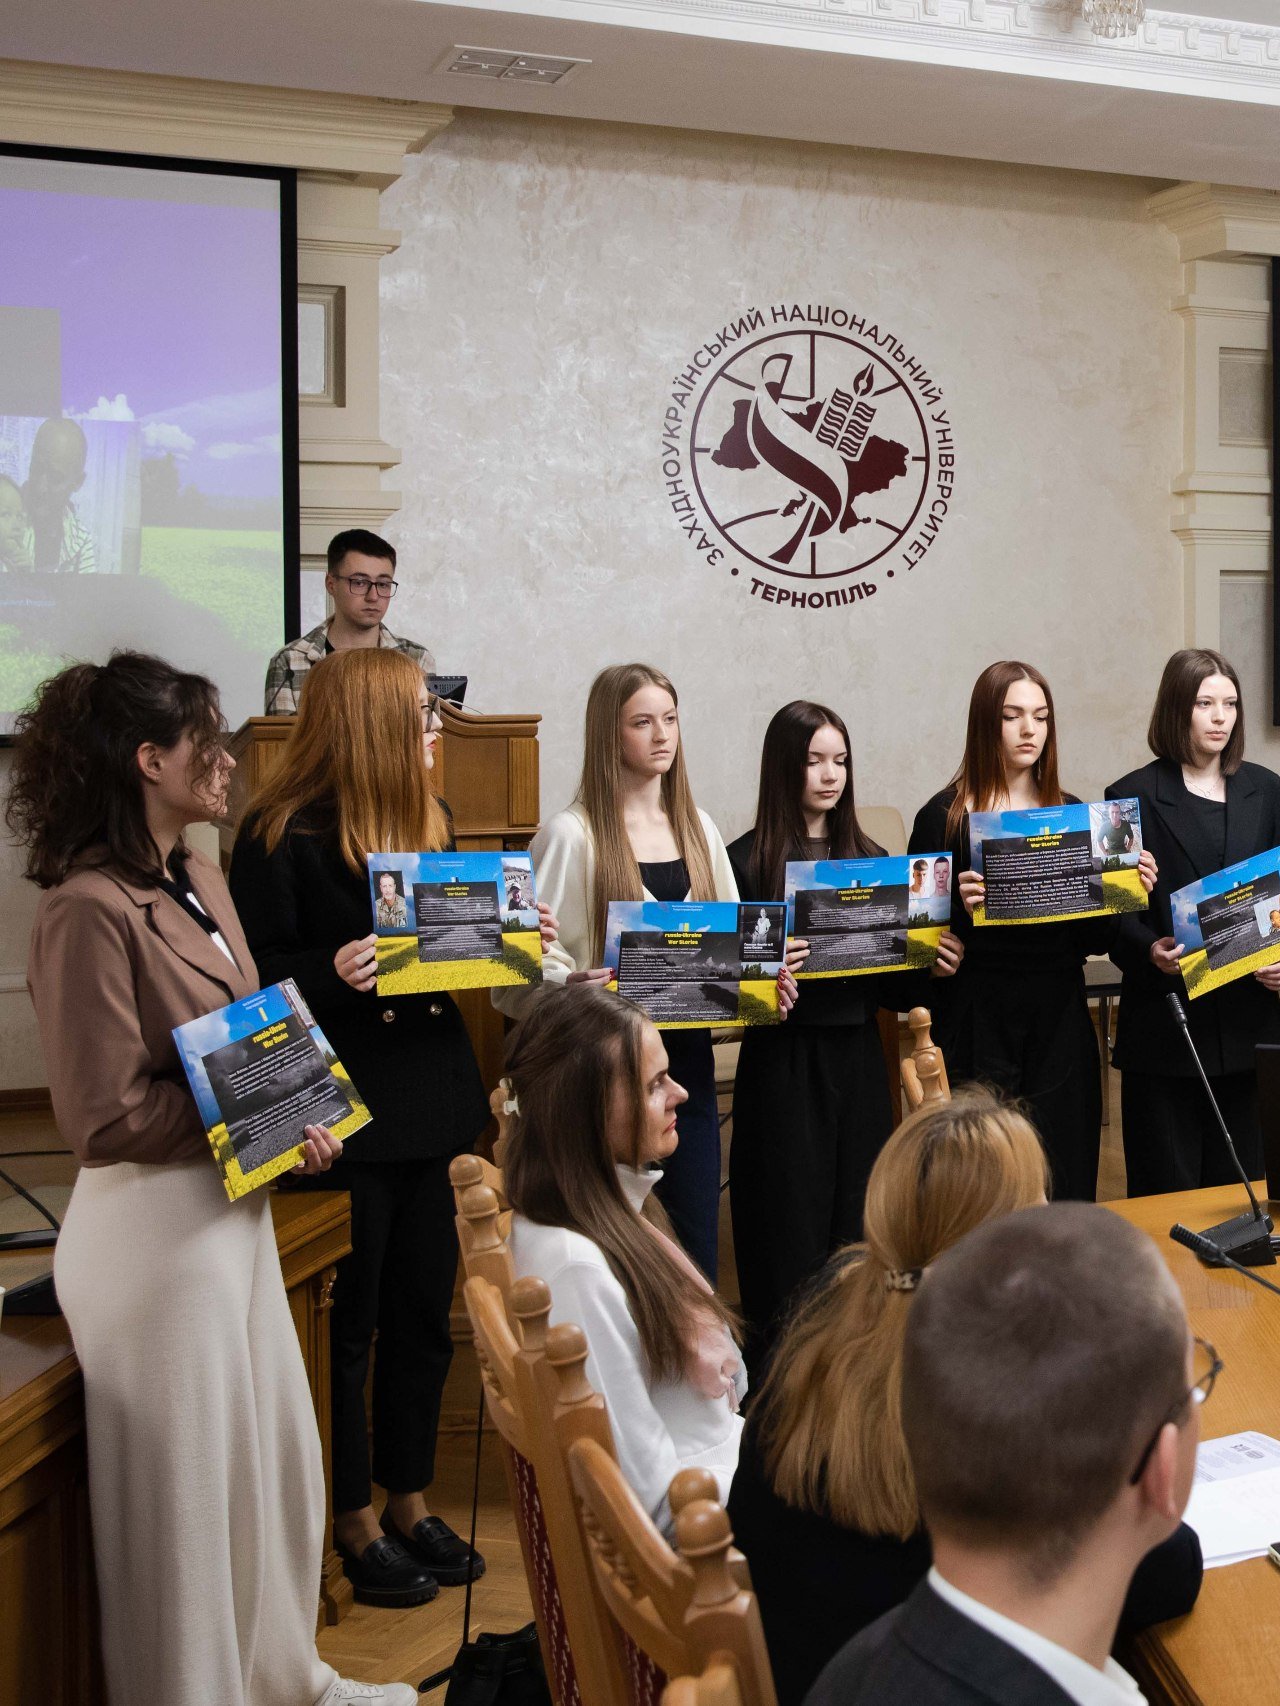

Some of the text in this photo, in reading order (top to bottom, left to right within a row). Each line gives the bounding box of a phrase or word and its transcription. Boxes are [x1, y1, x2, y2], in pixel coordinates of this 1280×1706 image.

[662, 304, 955, 571] ЗАХІДНОУКРАЇНСЬКИЙ НАЦІОНАЛЬНИЙ УНІВЕРСИТЕТ
[749, 577, 877, 609] ТЕРНОПІЛЬ
